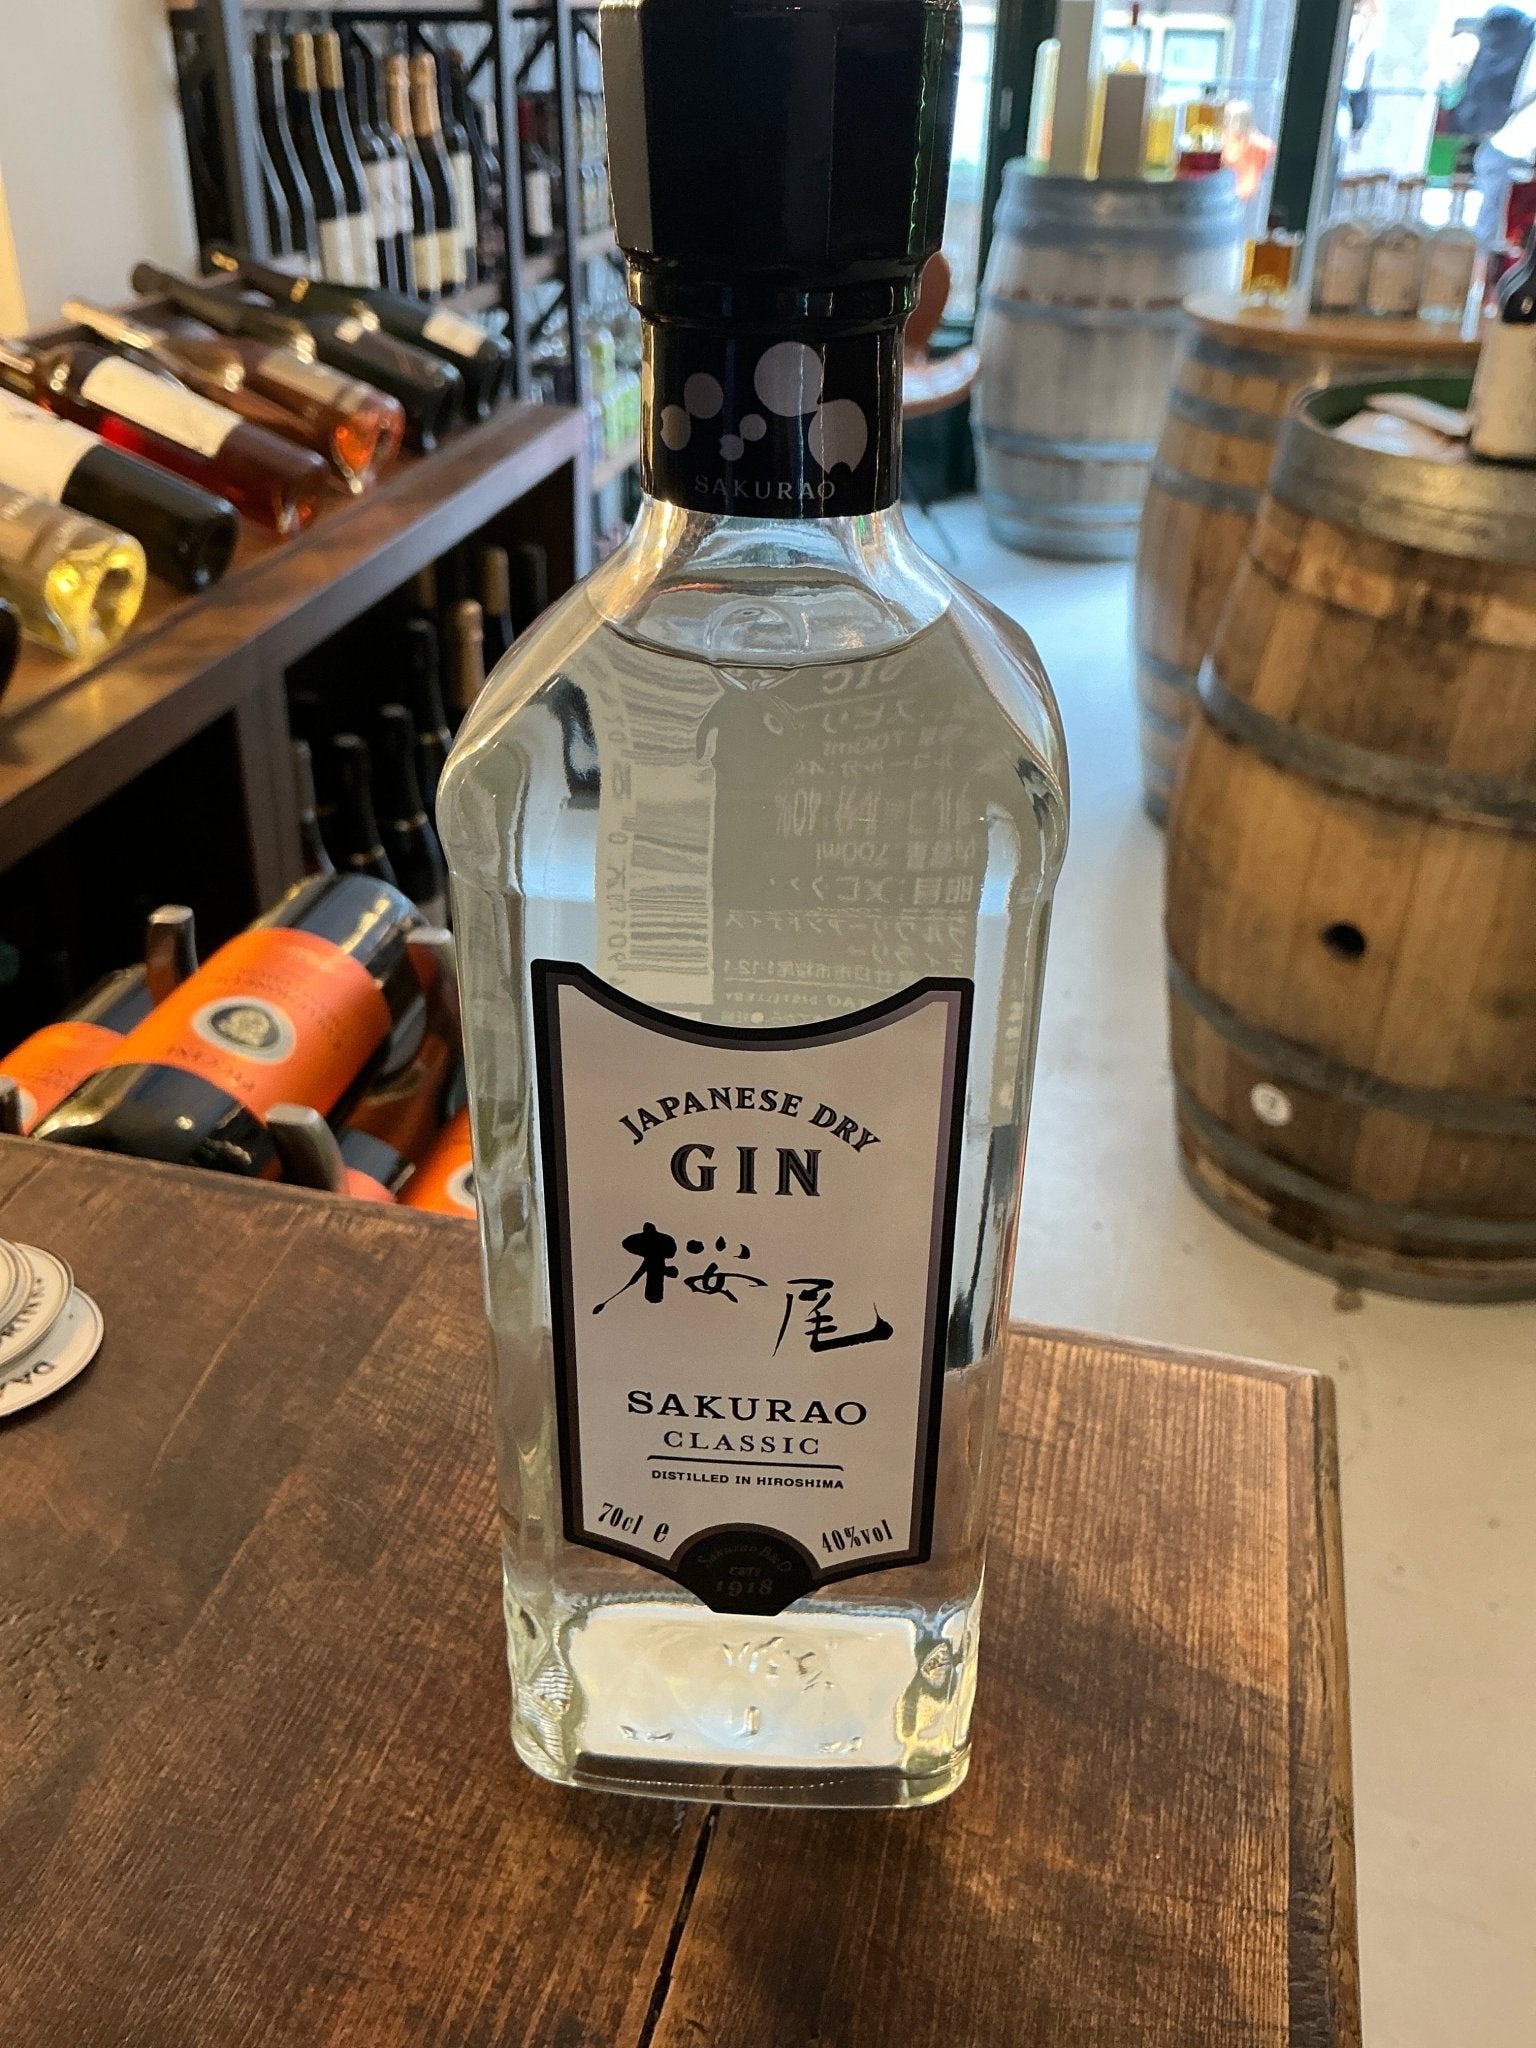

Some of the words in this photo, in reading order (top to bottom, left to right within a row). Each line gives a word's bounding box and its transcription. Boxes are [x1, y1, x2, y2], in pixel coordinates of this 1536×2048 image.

[694, 475, 836, 500] SAKURAO
[618, 1086, 803, 1146] JAPANESE
[808, 1103, 881, 1153] DRY
[670, 1143, 822, 1197] GIN
[592, 1222, 894, 1358] 桜尾
[627, 1390, 867, 1425] SAKURAO
[663, 1430, 820, 1455] CLASSIC
[651, 1470, 730, 1484] DISTILLED
[735, 1475, 751, 1485] IN
[756, 1476, 844, 1489] HIROSHIMA
[598, 1502, 644, 1535] 70cl
[821, 1518, 893, 1553] 40%vol
[716, 1579, 774, 1597] 1918
